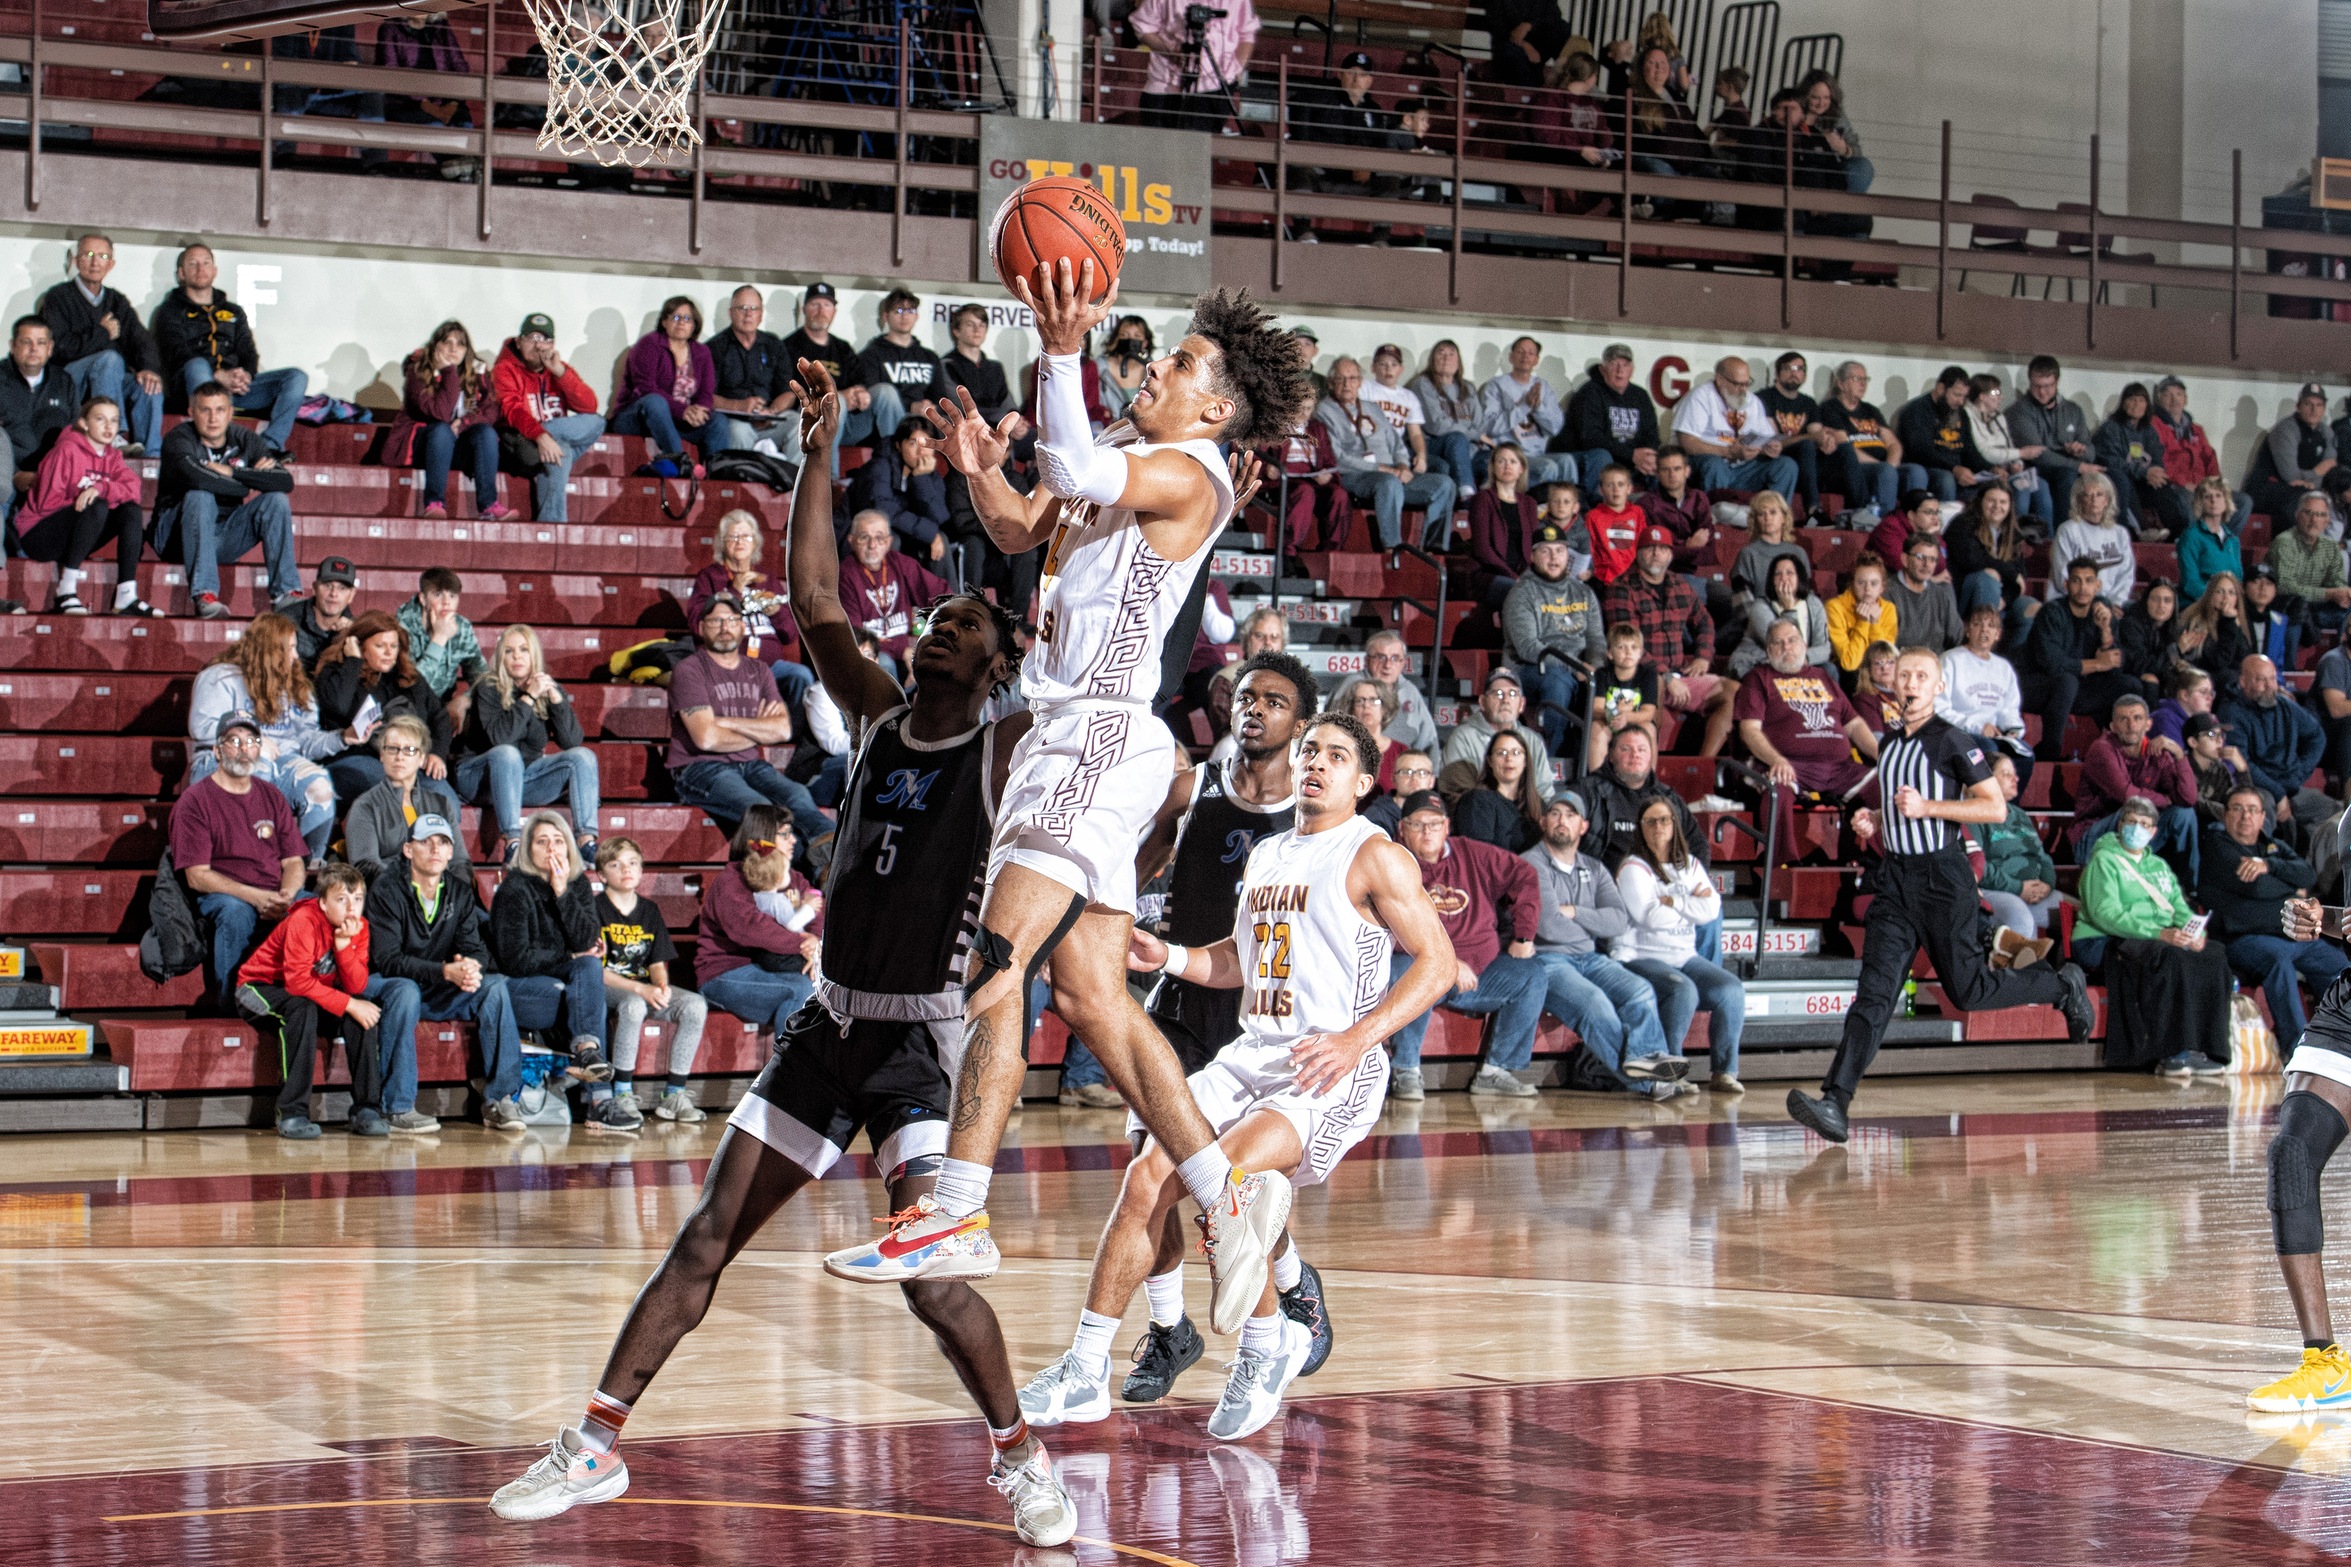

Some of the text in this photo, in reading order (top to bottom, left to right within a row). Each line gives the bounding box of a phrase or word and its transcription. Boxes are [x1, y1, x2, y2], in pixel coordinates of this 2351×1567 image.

[989, 158, 1026, 181] GO
[1173, 203, 1203, 225] TV
[1149, 236, 1204, 257] Today!
[237, 264, 283, 329] F
[884, 361, 934, 385] VANS
[1651, 355, 1693, 409] G
[1211, 557, 1274, 576] 4-5151
[875, 822, 904, 876] 5
[1253, 921, 1292, 979] 22
[1, 1032, 77, 1045] FAREWAY
